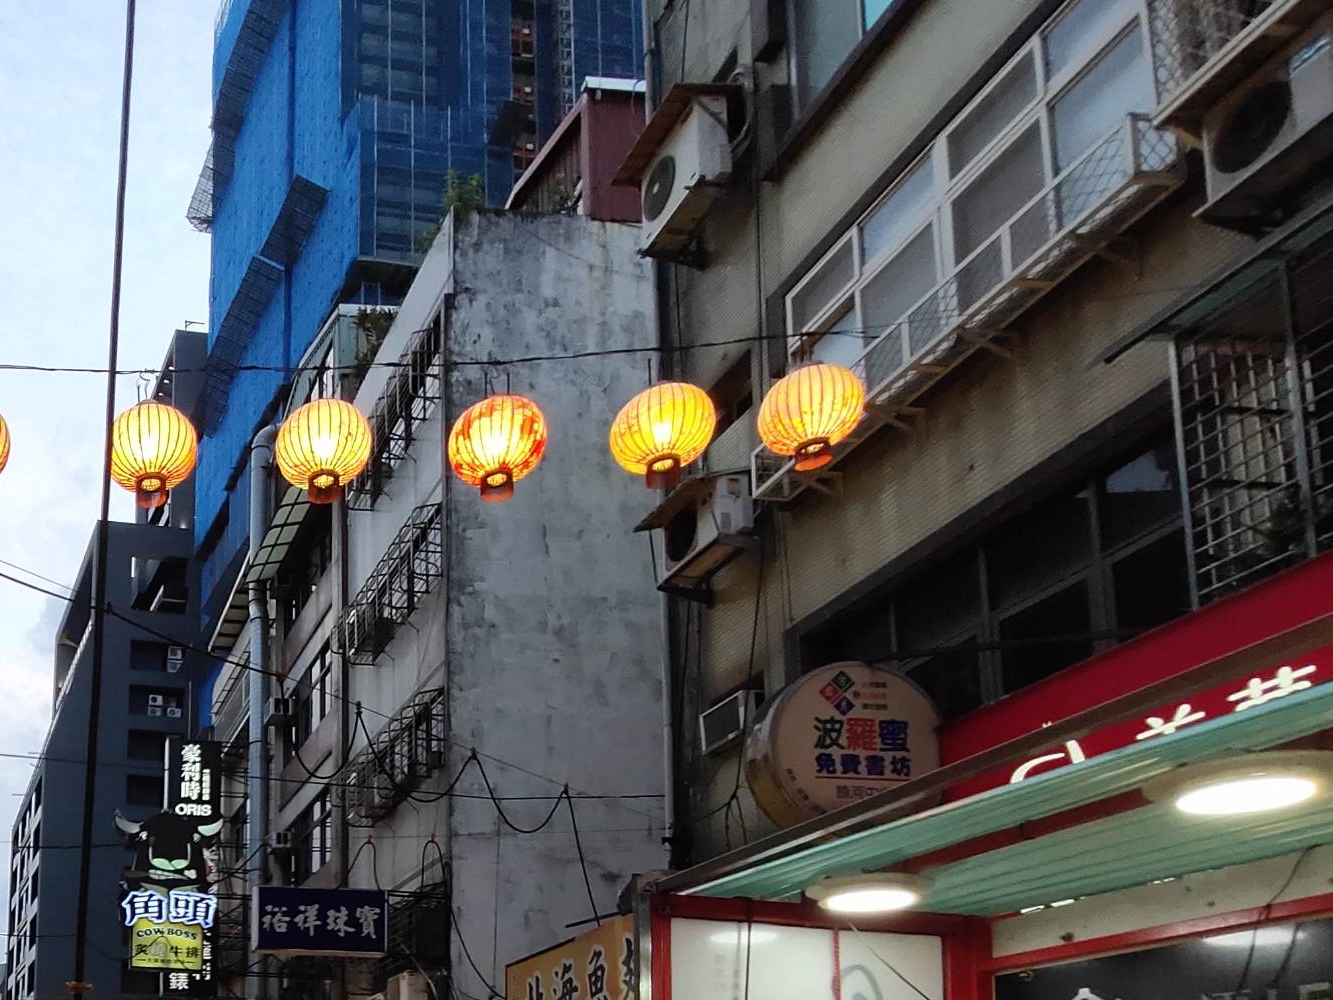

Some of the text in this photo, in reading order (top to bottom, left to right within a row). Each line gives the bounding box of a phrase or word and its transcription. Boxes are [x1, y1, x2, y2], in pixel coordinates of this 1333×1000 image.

[814, 716, 910, 753] 波羅蜜
[815, 752, 912, 777] 免費書坊
[175, 803, 212, 817] ORIS
[122, 890, 218, 928] 角頭
[261, 904, 382, 939] 裕祥珠寶
[136, 927, 198, 941] COW BOSS
